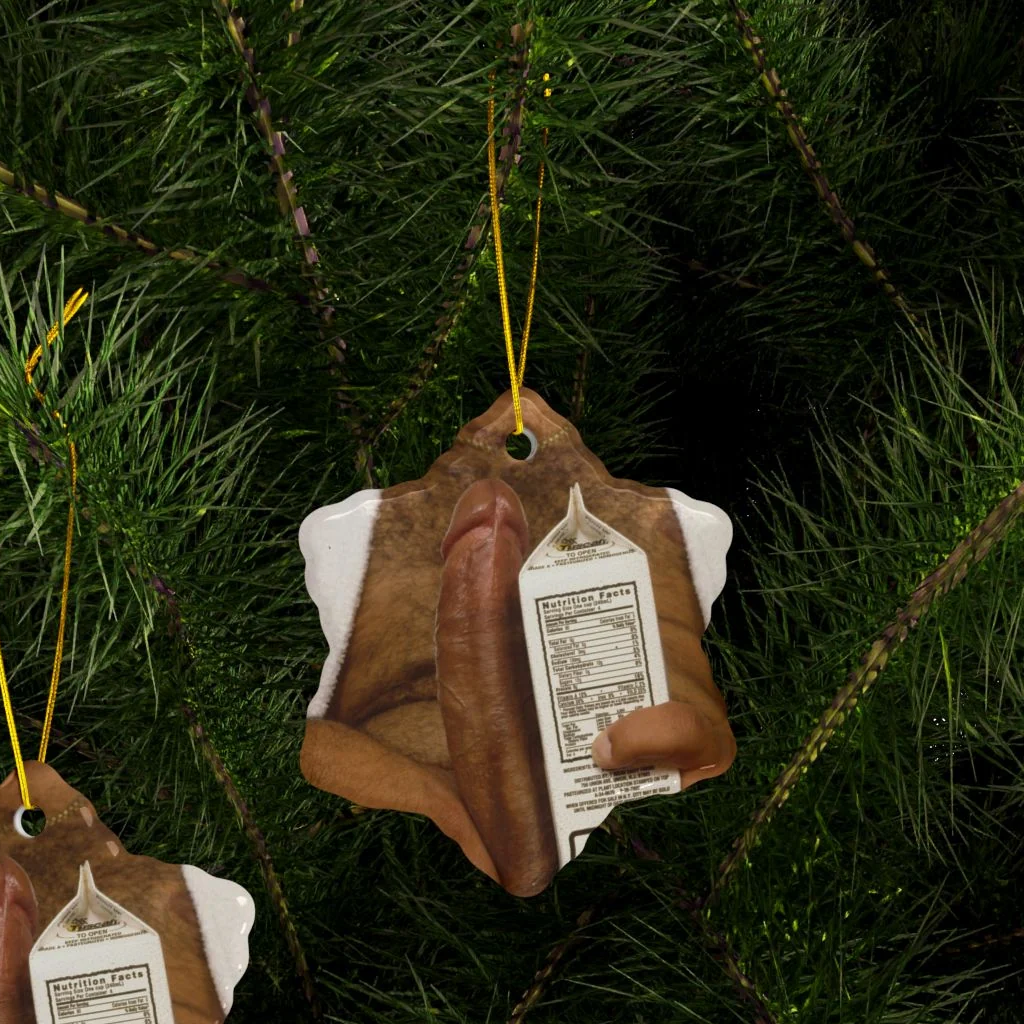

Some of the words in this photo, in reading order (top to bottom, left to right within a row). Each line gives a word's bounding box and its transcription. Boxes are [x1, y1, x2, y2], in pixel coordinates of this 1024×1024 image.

[577, 548, 597, 556] OPEN
[542, 595, 594, 610] Nutrition
[599, 589, 631, 600] Facts
[53, 978, 106, 993] Nutrition
[111, 971, 143, 983] Facts
